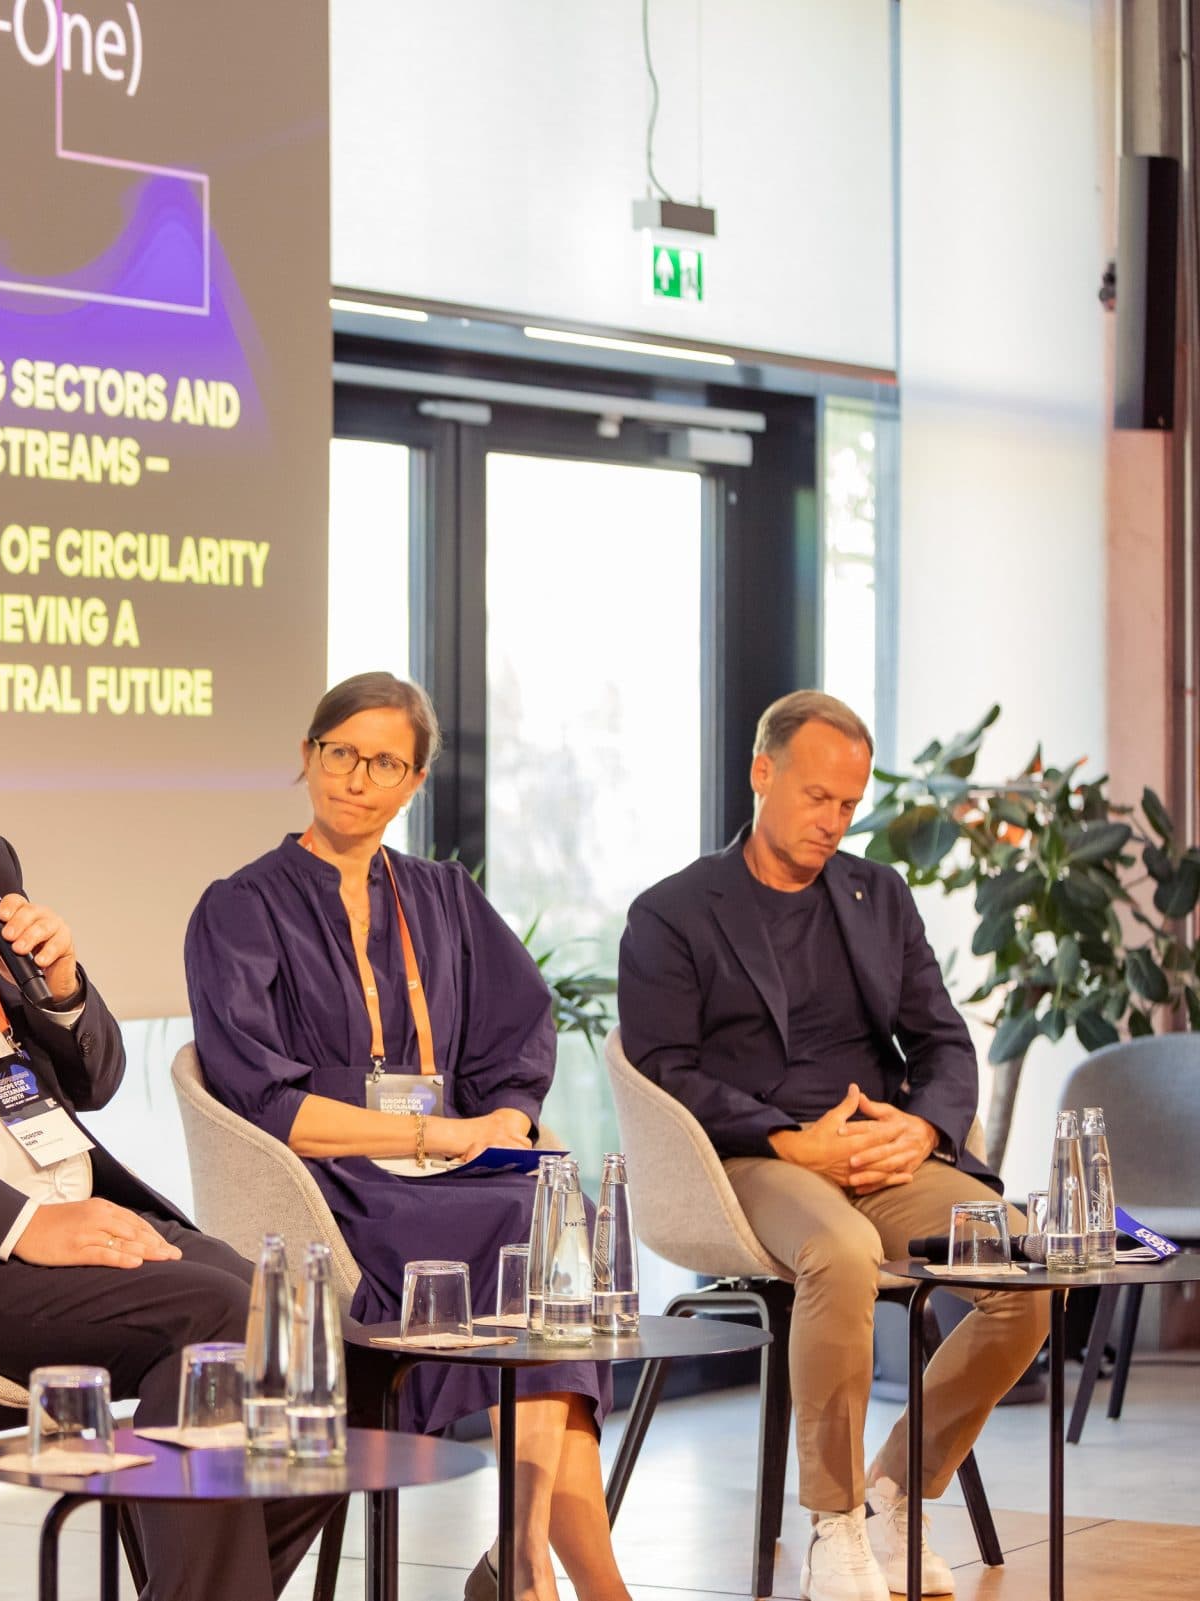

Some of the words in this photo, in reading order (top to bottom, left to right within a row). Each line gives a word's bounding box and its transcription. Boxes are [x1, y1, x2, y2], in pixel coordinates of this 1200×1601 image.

[11, 357, 168, 422] SECTORS
[171, 376, 241, 430] AND
[0, 524, 51, 575] OF
[55, 527, 270, 588] CIRCULARITY
[112, 599, 141, 648] A
[86, 665, 213, 717] FUTURE
